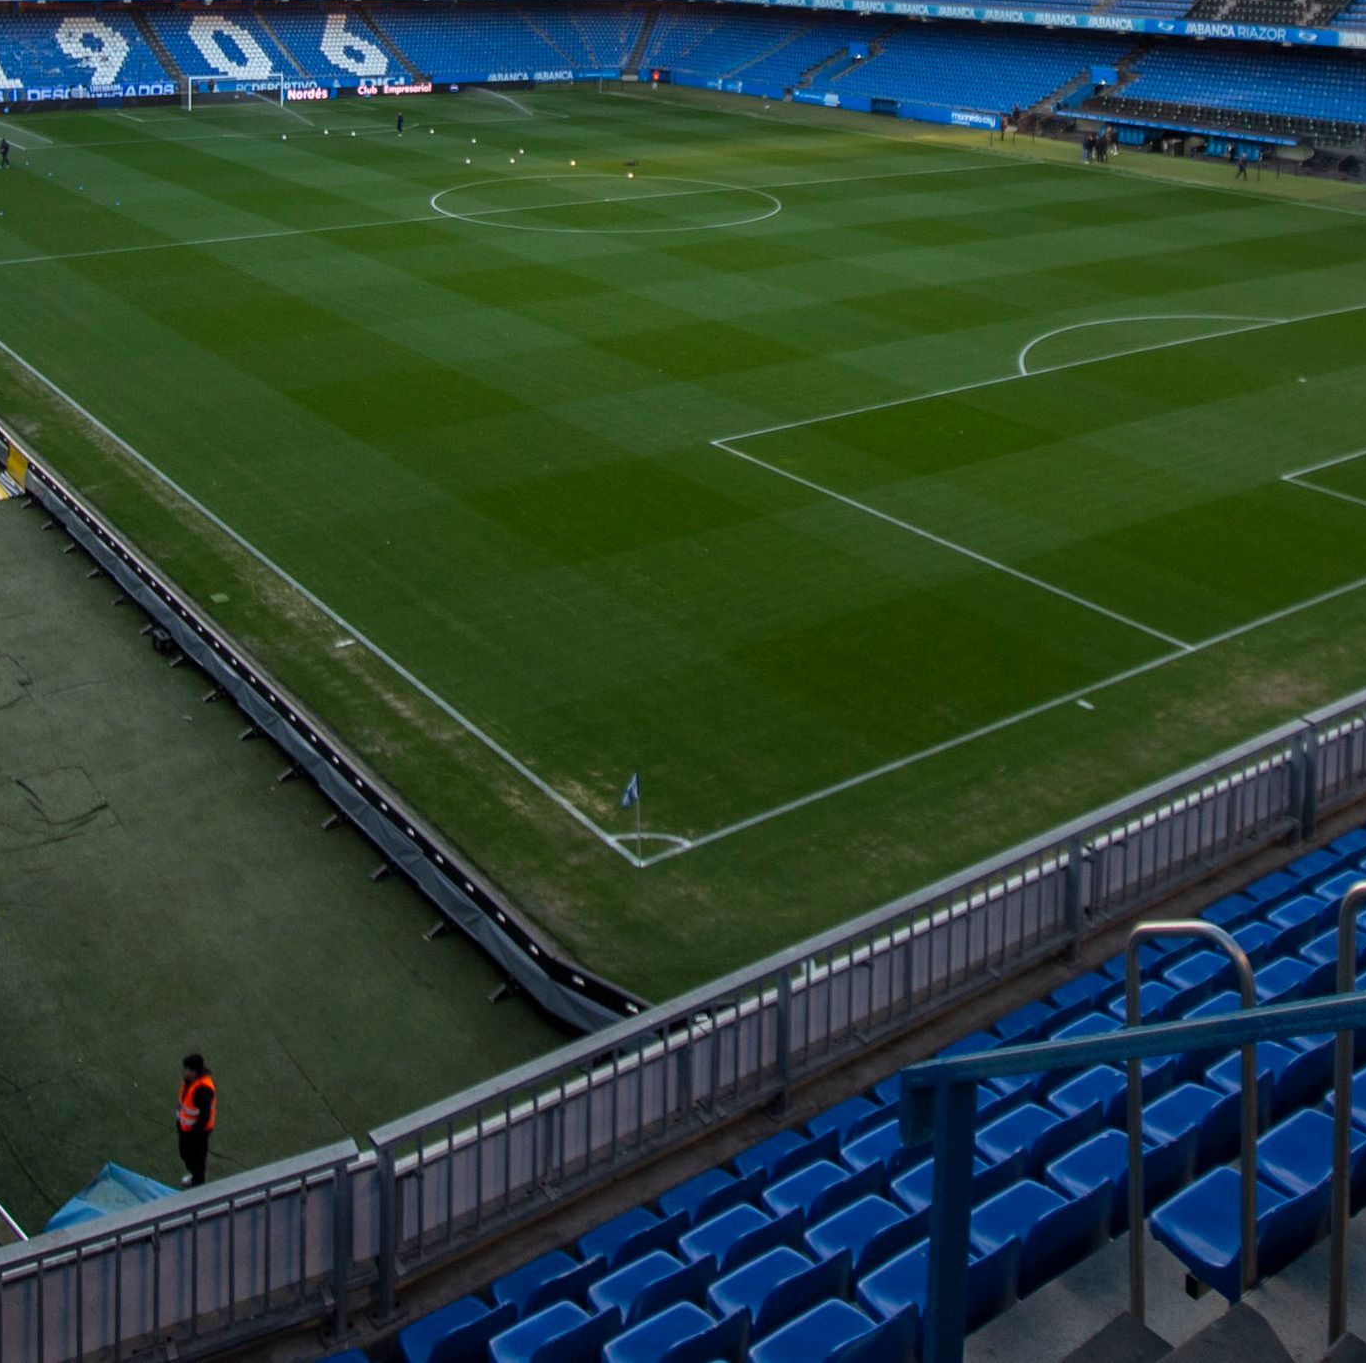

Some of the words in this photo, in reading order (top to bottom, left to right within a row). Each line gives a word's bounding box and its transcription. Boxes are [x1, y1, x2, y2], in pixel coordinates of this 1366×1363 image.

[287, 87, 328, 101] Nordés
[358, 85, 377, 95] Club
[383, 82, 432, 95] Empresarial
